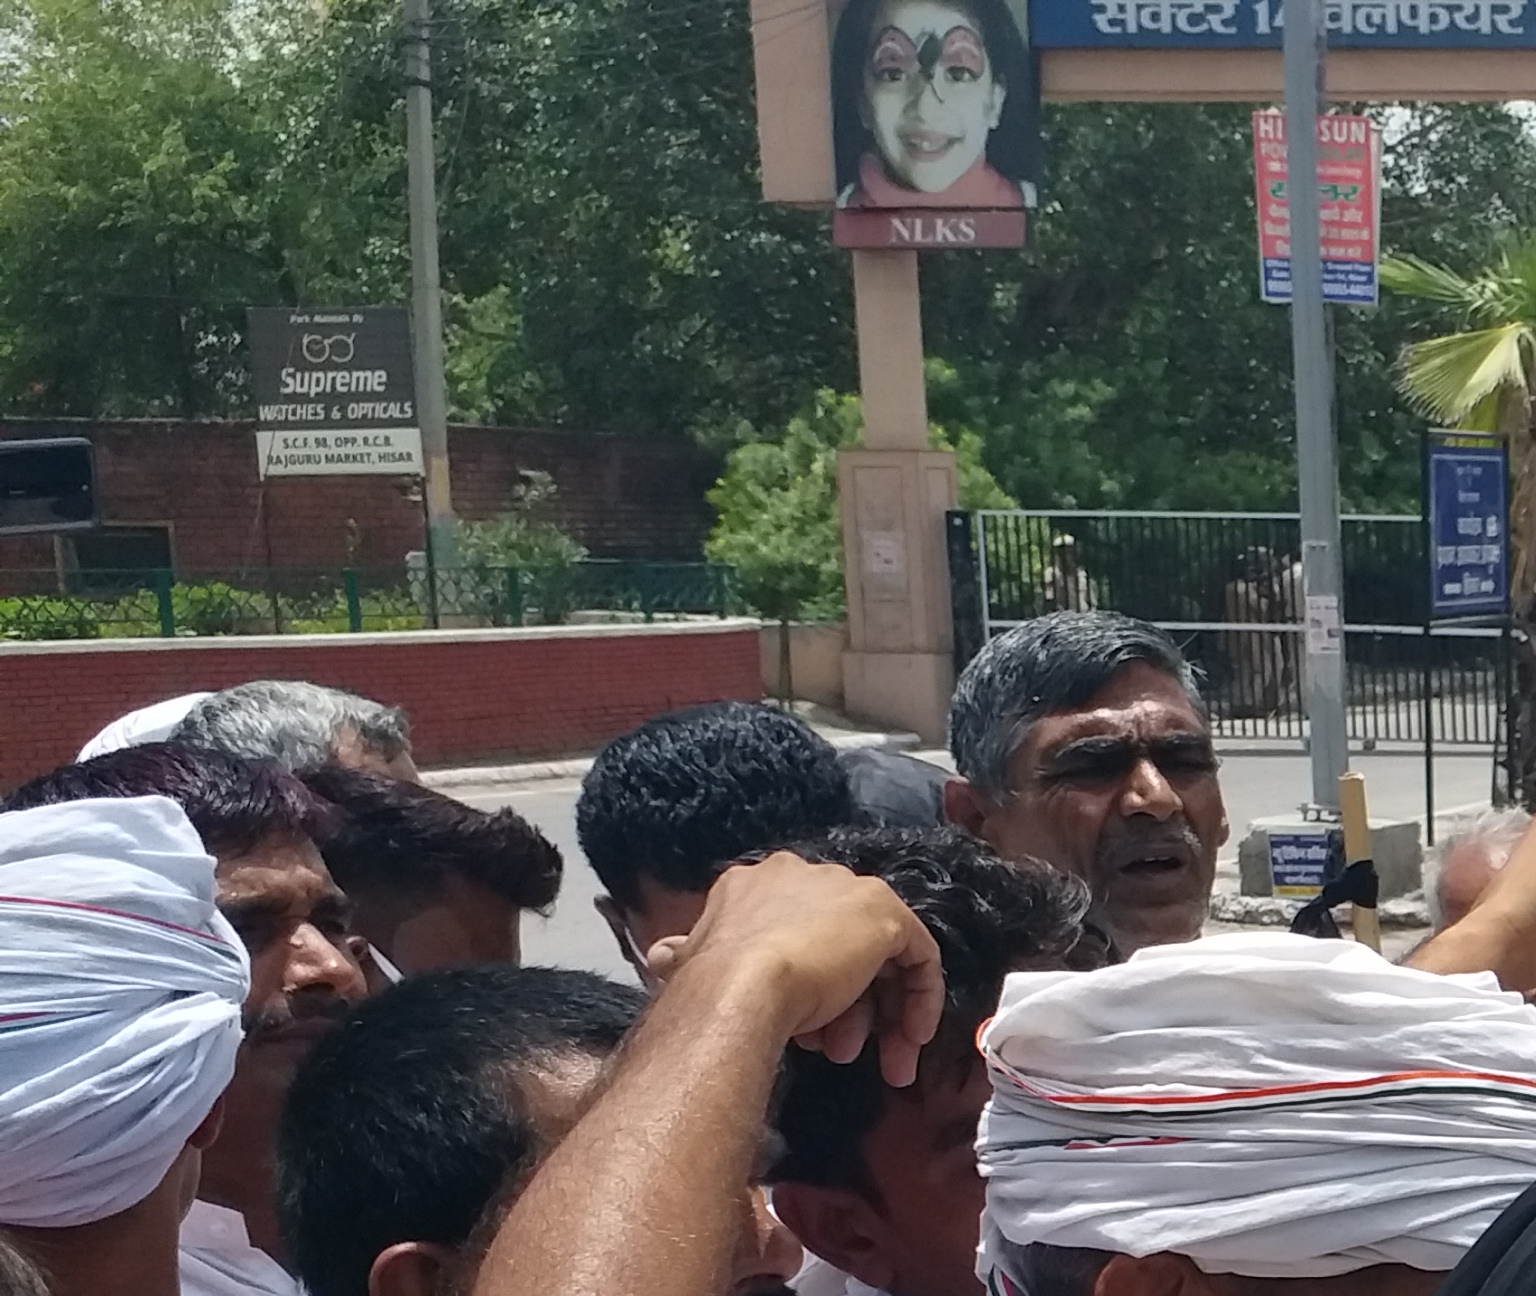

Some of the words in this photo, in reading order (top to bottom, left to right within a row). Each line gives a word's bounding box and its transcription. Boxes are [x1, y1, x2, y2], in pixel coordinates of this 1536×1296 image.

[888, 217, 976, 243] NLKS
[279, 367, 388, 398] Supreme
[259, 403, 326, 422] WATCHES
[331, 405, 342, 420] &
[347, 401, 414, 420] OPTICALS
[378, 451, 415, 465] HISAR
